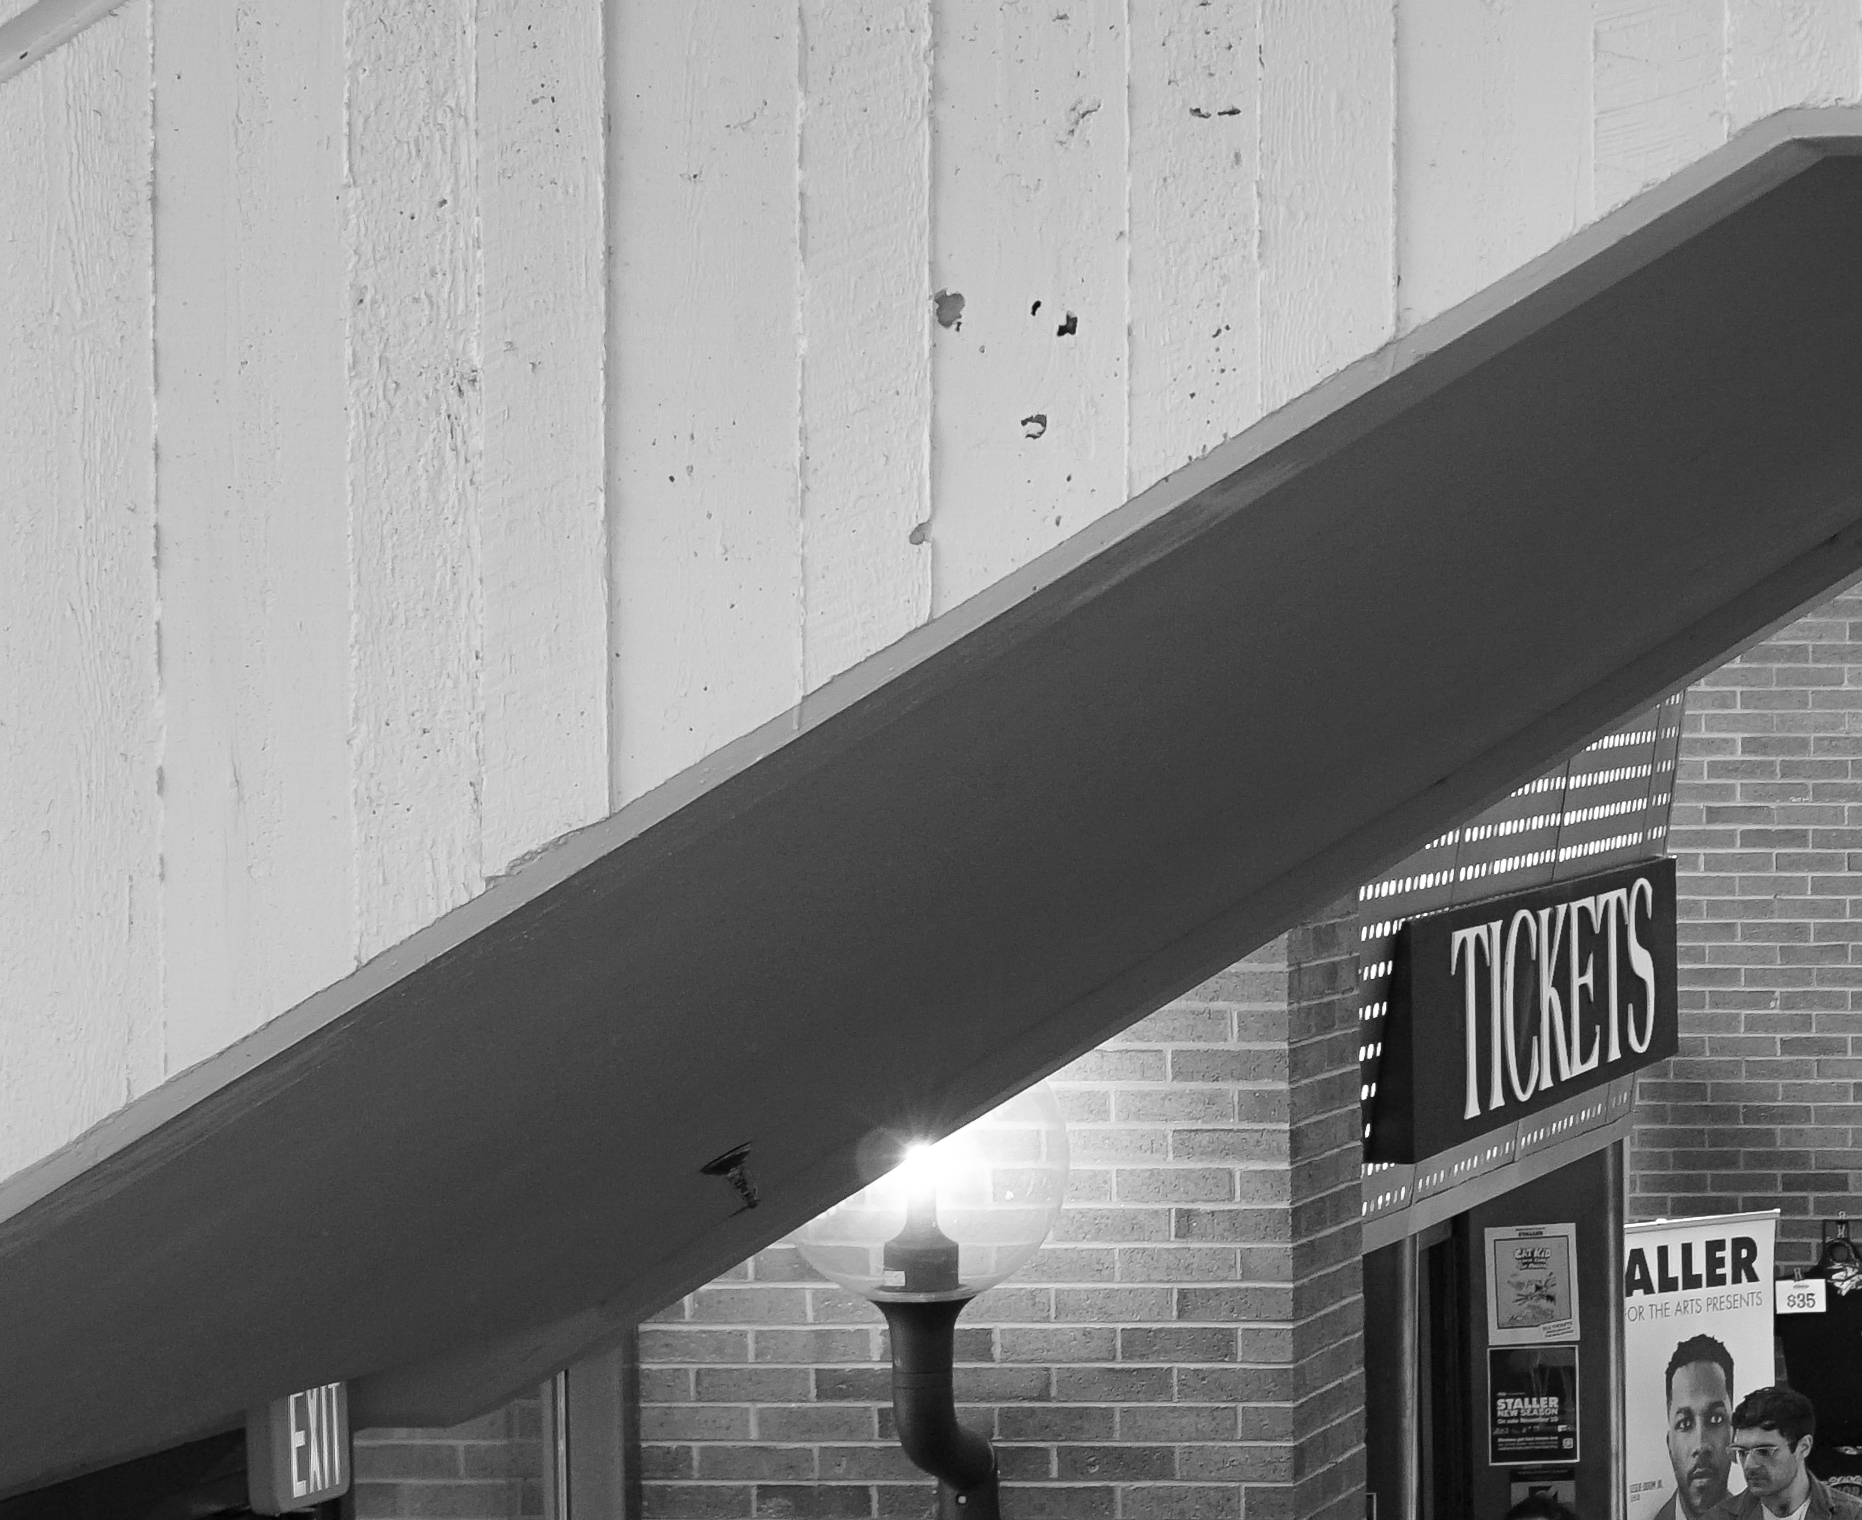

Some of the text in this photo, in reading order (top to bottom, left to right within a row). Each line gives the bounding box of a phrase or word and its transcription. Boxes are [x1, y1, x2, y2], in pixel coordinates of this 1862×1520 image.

[1449, 877, 1657, 1121] TICKETS
[1625, 1291, 1764, 1322] OR THE ARTS PRESENTS
[1786, 1292, 1817, 1309] $35
[1496, 1396, 1559, 1411] STALLER
[288, 1381, 341, 1498] EXIT
